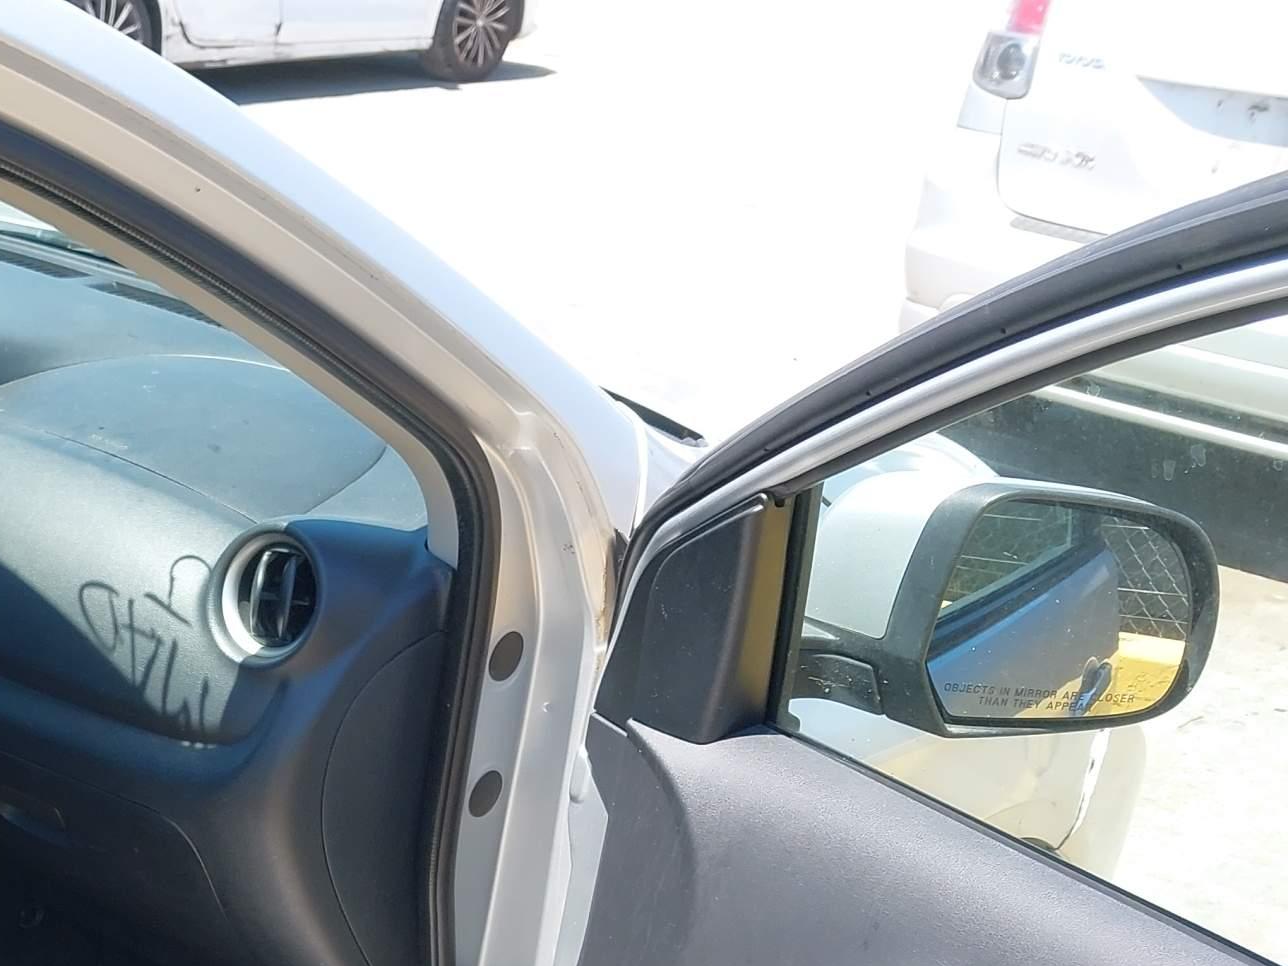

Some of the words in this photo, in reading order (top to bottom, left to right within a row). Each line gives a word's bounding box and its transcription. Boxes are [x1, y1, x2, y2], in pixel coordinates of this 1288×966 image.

[944, 682, 995, 695] OBJECTS
[999, 687, 1011, 697] IN
[1014, 687, 1058, 699] MIRROR
[1062, 691, 1089, 701] ARE
[1095, 693, 1136, 703] LOSER
[979, 696, 1008, 706] THAN
[1013, 699, 1041, 709] THEY
[1046, 702, 1092, 713] APPEA
